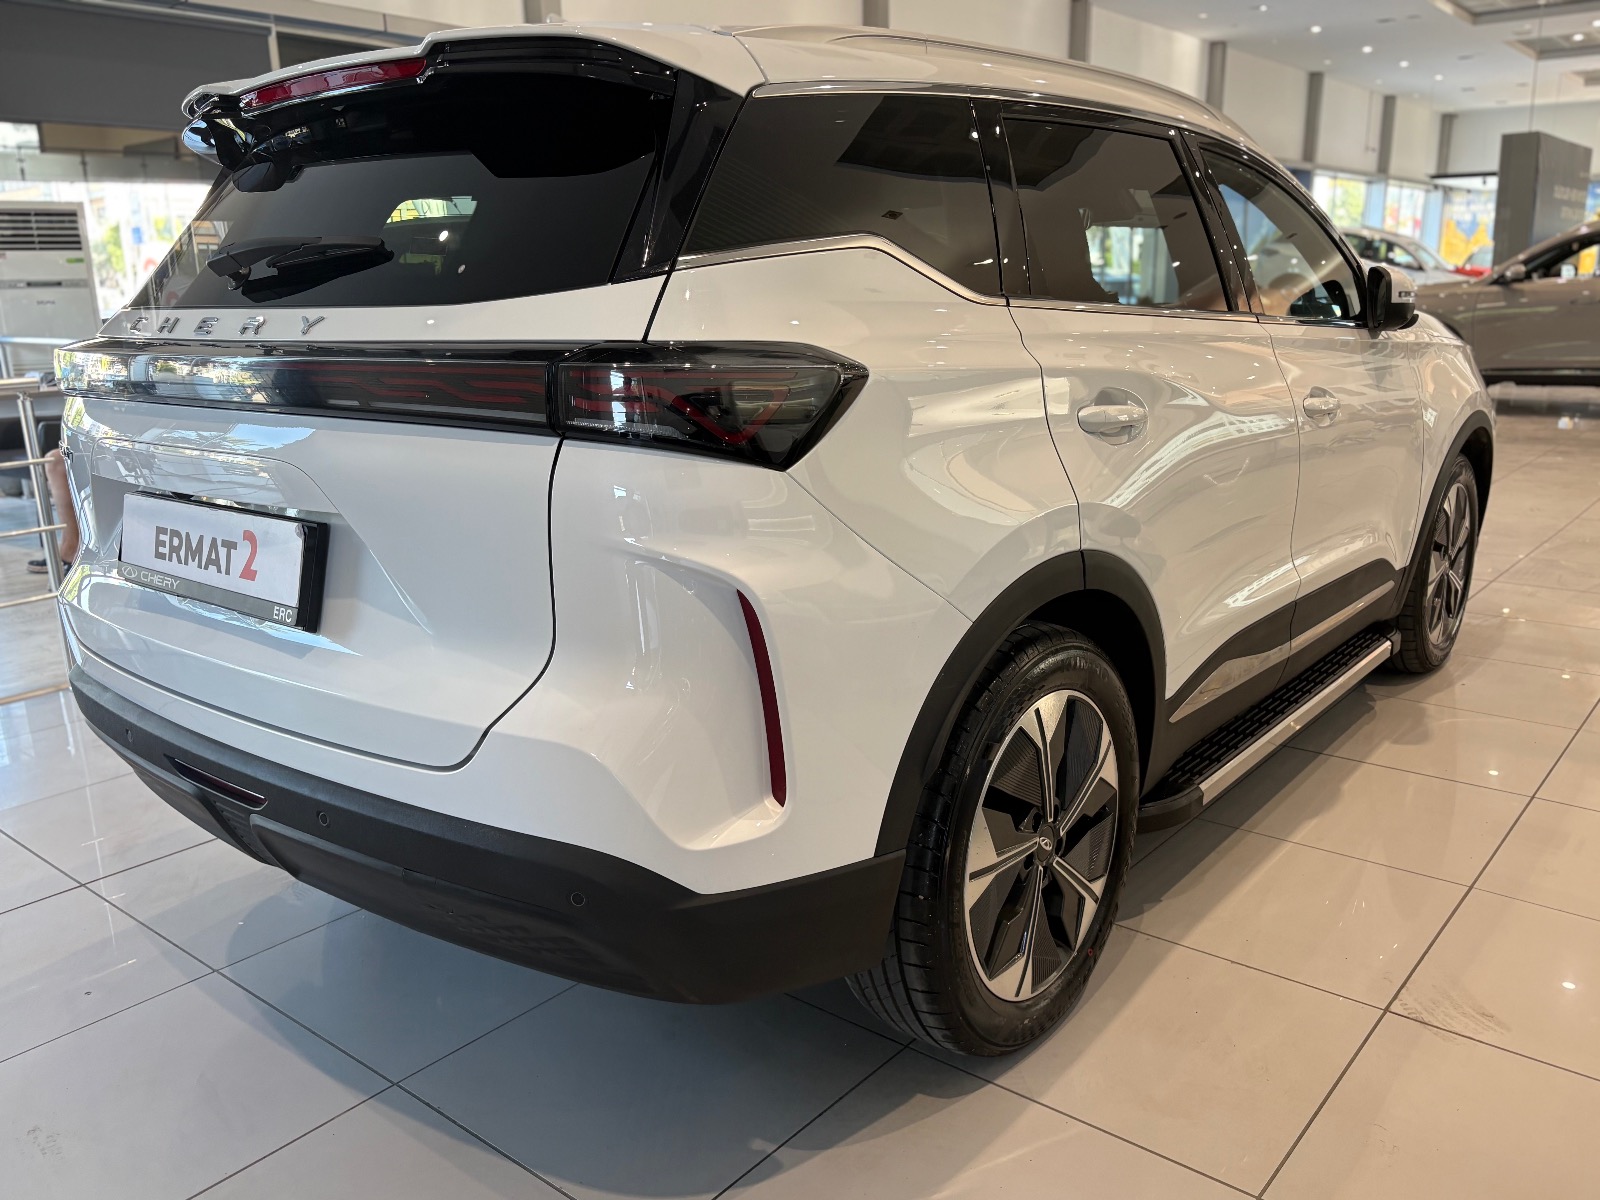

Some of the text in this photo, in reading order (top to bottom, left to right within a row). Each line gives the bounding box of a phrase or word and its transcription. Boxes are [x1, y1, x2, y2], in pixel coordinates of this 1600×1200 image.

[129, 315, 326, 336] CHERY
[154, 525, 259, 582] ERMAT 2
[140, 570, 181, 590] CHERY
[273, 605, 293, 623] ERC
